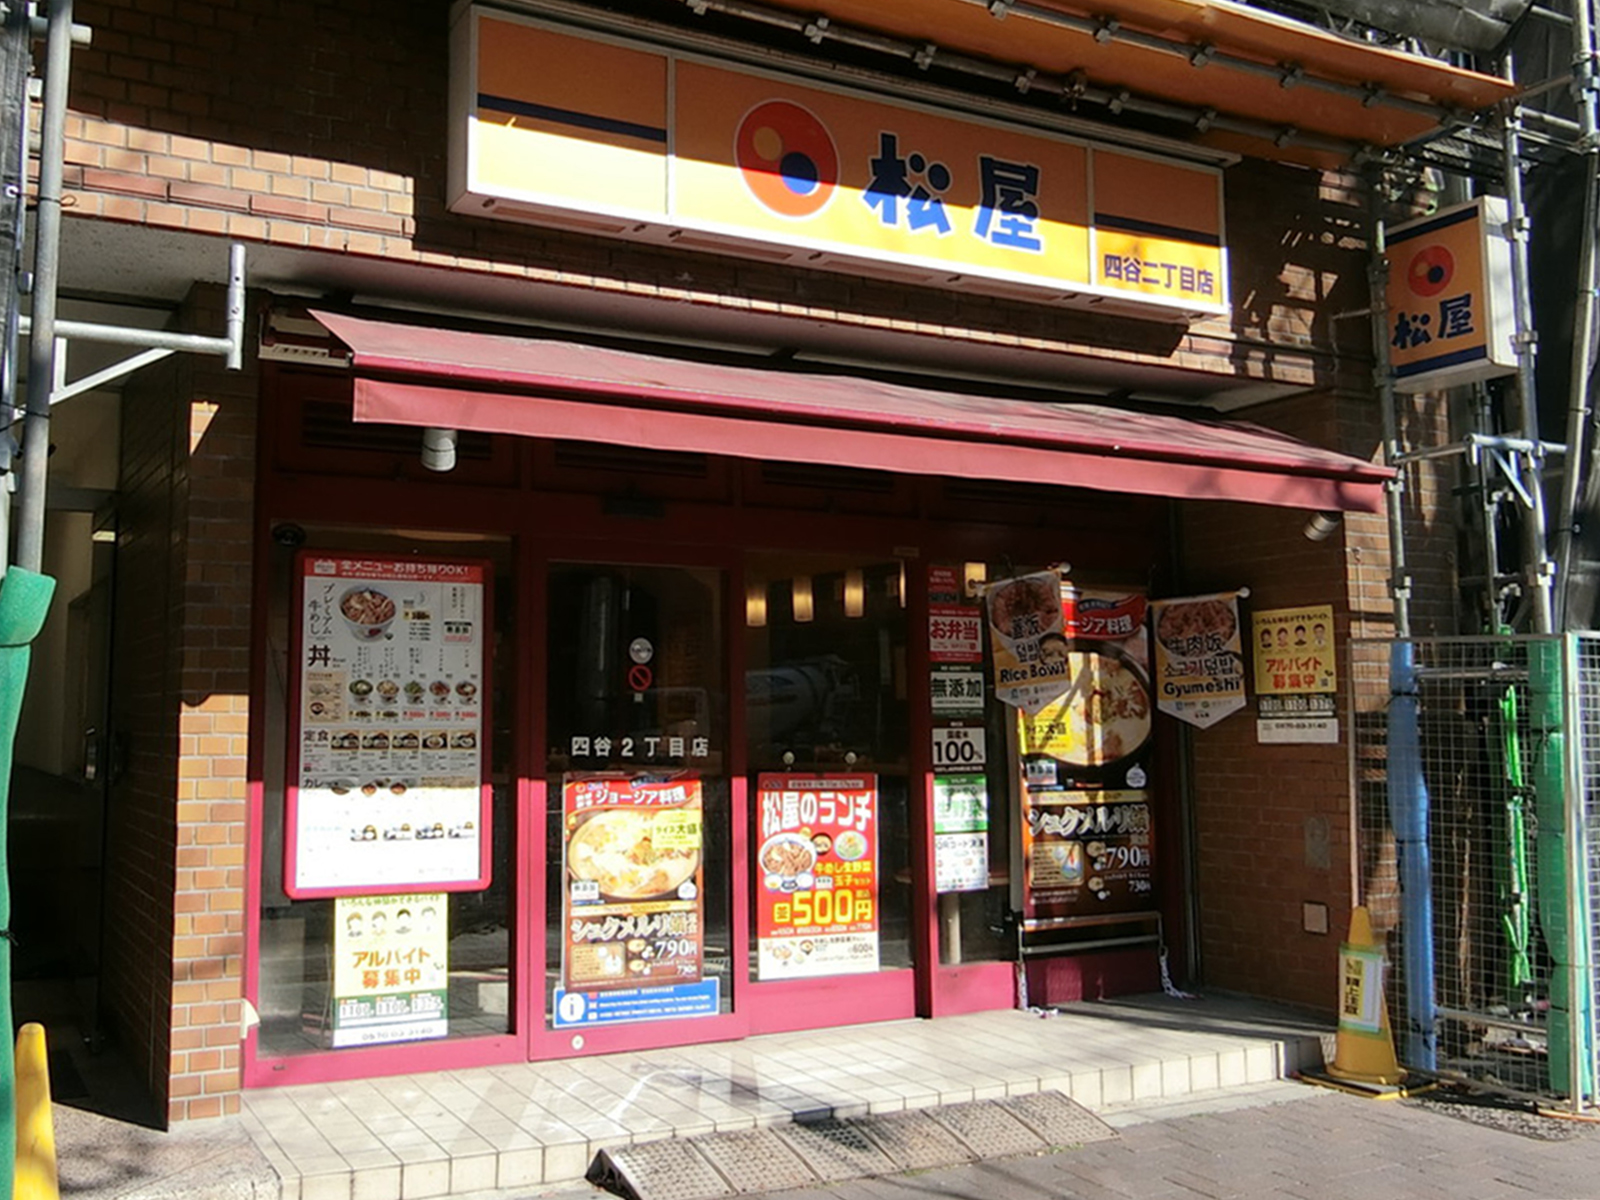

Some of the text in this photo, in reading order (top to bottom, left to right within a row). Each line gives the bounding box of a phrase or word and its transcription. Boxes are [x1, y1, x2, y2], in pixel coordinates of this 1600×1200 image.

[863, 132, 1042, 252] 松屋
[1102, 253, 1214, 296] 四谷二丁目店
[1391, 293, 1475, 350] 松屋
[931, 619, 978, 641] お弁当
[307, 645, 331, 668] 丼
[1265, 656, 1322, 673] アルバイト
[1001, 661, 1066, 683] Rice Bowl
[1272, 673, 1316, 689] 募集中
[932, 678, 981, 698] 無添加
[1163, 678, 1240, 698] Gyumeshi
[303, 730, 329, 742] 定食
[762, 791, 872, 838] 松屋のランチ
[793, 888, 872, 926] 500円
[362, 968, 421, 989] 募集中
